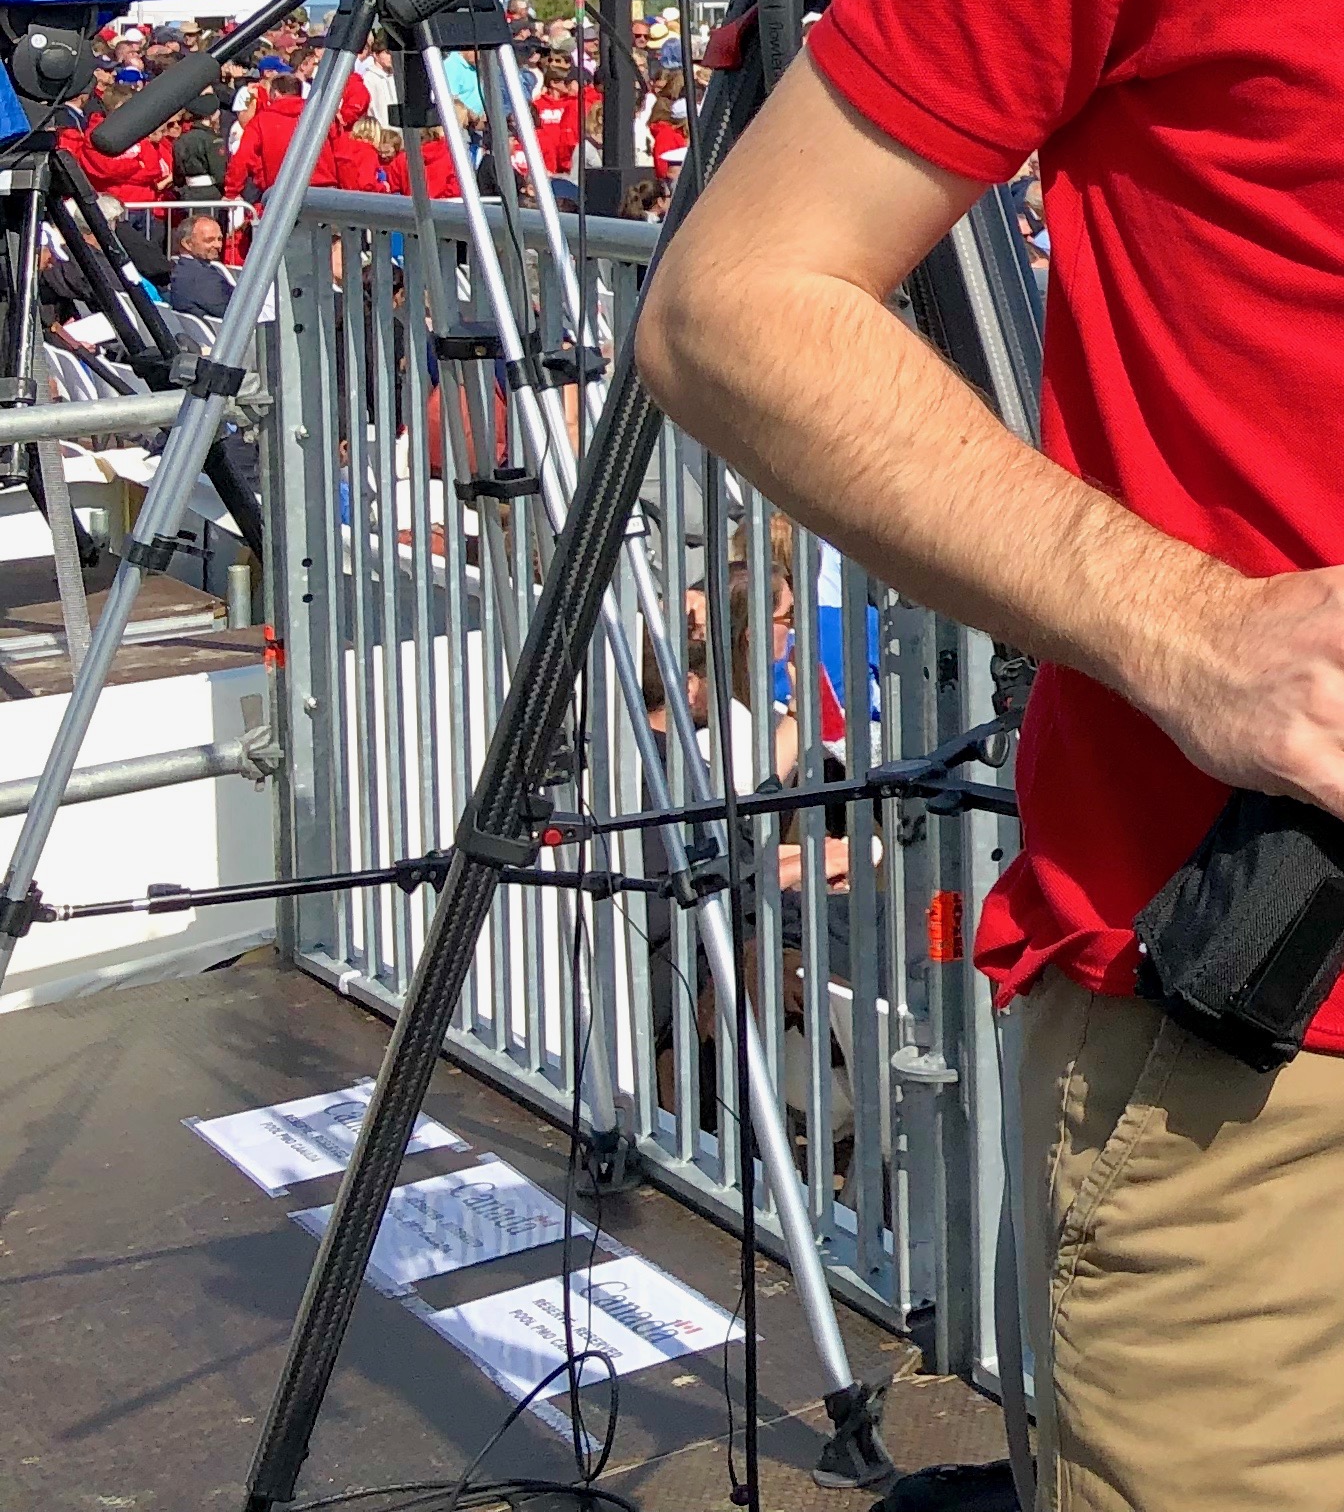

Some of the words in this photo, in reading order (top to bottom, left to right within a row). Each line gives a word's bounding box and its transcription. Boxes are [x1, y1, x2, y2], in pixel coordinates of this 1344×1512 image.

[450, 1182, 540, 1236] Canada
[509, 1308, 537, 1327] POOL
[579, 1281, 684, 1344] Canada
[573, 1326, 624, 1359] RESERVED
